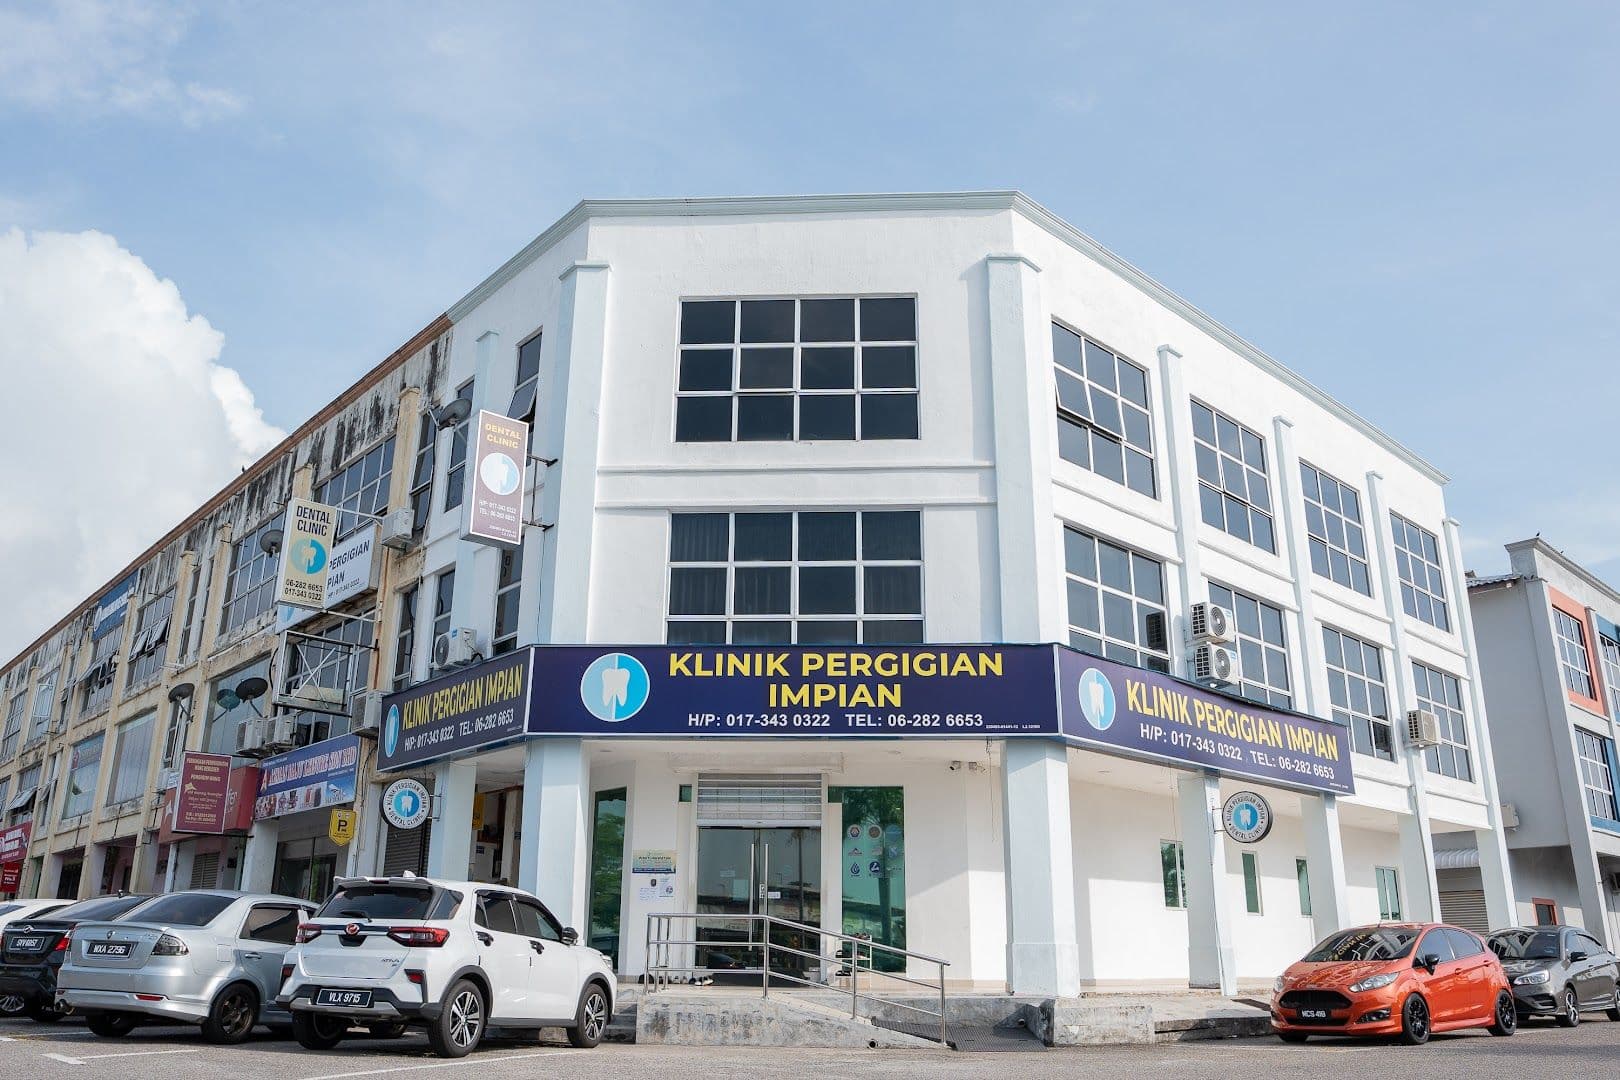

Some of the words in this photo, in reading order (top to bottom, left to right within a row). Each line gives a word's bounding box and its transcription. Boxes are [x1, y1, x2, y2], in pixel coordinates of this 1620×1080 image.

[485, 423, 521, 440] DENTAL
[487, 434, 519, 449] CLINIC
[296, 506, 331, 524] DENTAL
[298, 520, 327, 536] CLINIC
[286, 579, 306, 590] 06-282
[308, 584, 322, 592] 6653
[327, 571, 345, 590] PIAN
[285, 588, 306, 598] 017-343
[308, 592, 322, 600] 0322
[669, 652, 790, 677] KLINIK
[802, 652, 1003, 677] PERGIGIAN
[402, 694, 432, 730] KLINIK
[432, 676, 484, 722] PERGIGIAN
[485, 664, 523, 706] IMPIAN
[769, 683, 902, 708] IMPIAN
[688, 714, 721, 726] H/P:
[726, 714, 788, 726] 017-343
[793, 714, 830, 726] 0322
[846, 714, 882, 726] TEL:
[888, 714, 940, 726] 06-282
[946, 714, 983, 726] 6653
[1126, 680, 1192, 725] KLINIK
[1193, 698, 1282, 749] PERGIGIAN
[1284, 723, 1339, 762] IMPIAN
[404, 737, 416, 751] H/P:
[417, 728, 438, 748] 017-343
[440, 725, 455, 742] 0322
[459, 722, 474, 737] TEL:
[475, 713, 496, 732] 06-282
[498, 708, 514, 726] 6653
[1140, 724, 1167, 744] H/P:
[1170, 730, 1216, 754] 017-343
[1218, 742, 1242, 761] 0322
[1250, 750, 1276, 768] TEL:
[1278, 756, 1312, 774] 06-282
[1314, 764, 1335, 780] 6653
[338, 820, 348, 832] P
[329, 992, 342, 1002] VLX
[343, 993, 361, 1002] 9715
